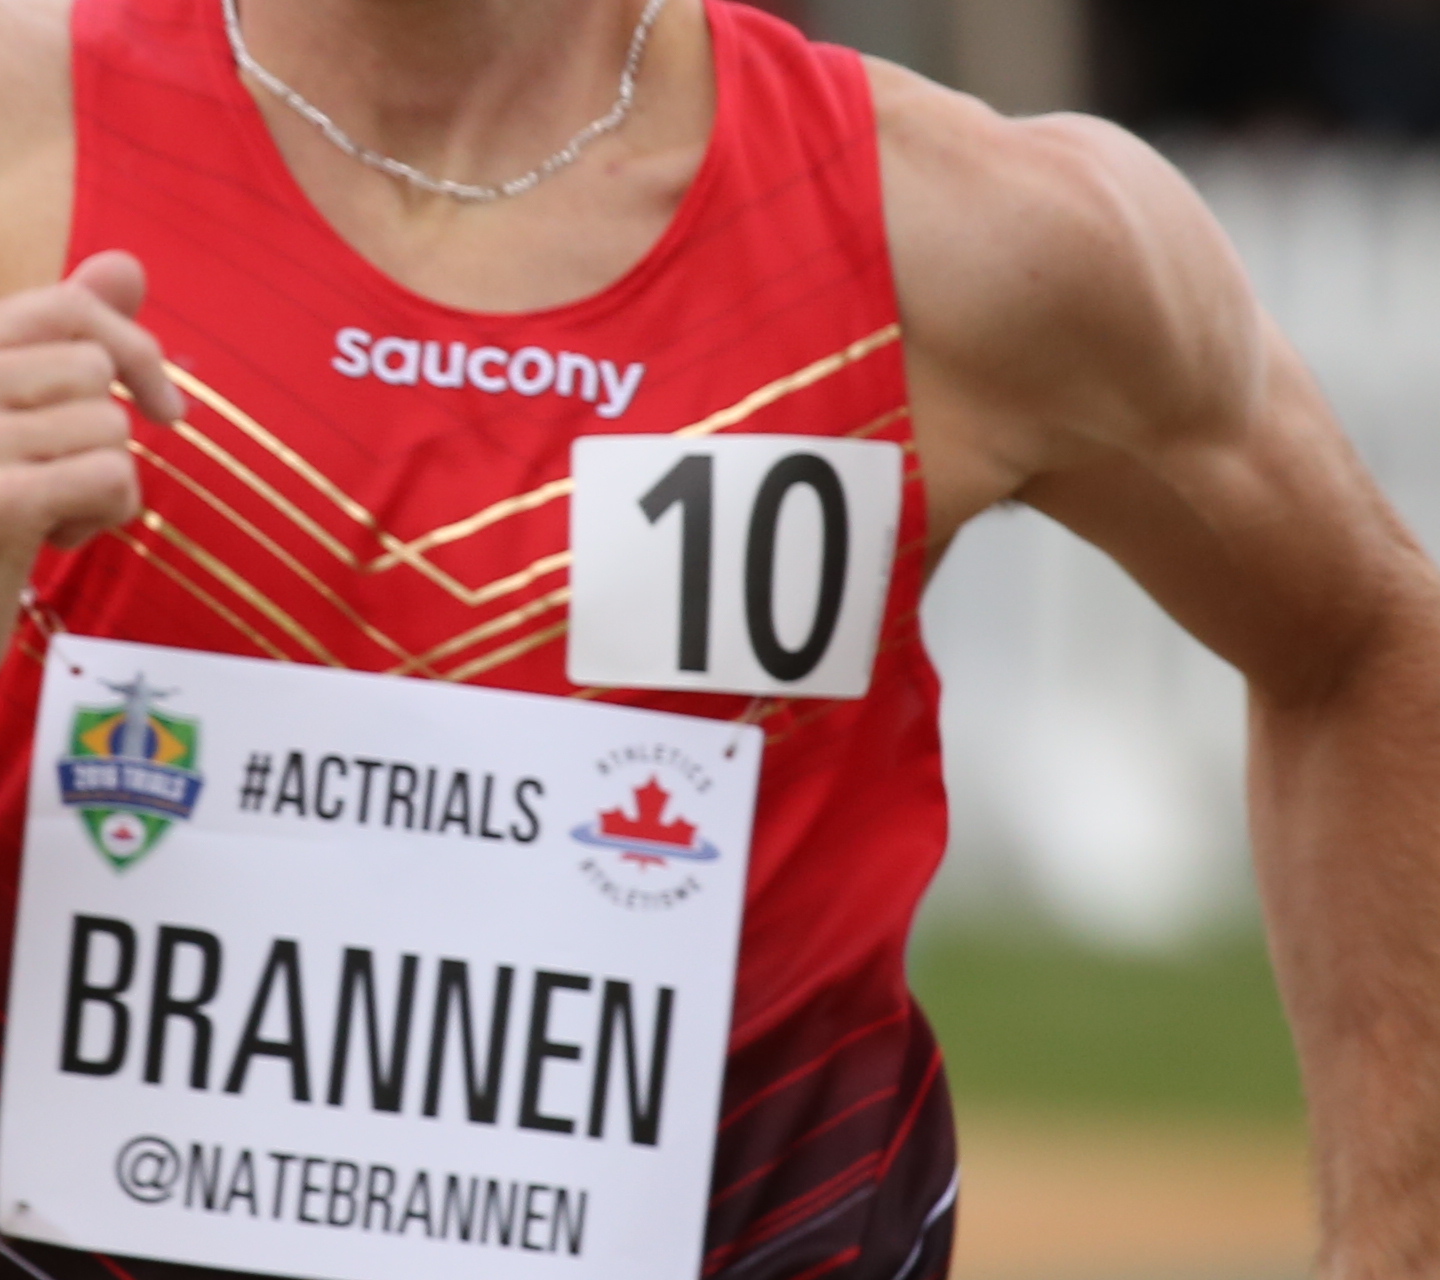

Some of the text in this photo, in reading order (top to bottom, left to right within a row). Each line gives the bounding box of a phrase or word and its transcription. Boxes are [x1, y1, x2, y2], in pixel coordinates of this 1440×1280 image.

[331, 326, 645, 418] saucony
[637, 452, 849, 683] 10
[238, 749, 545, 844] #ACTRIALS
[58, 912, 675, 1148] BRANNEN
[116, 1135, 587, 1256] @NATEBRANNEN
